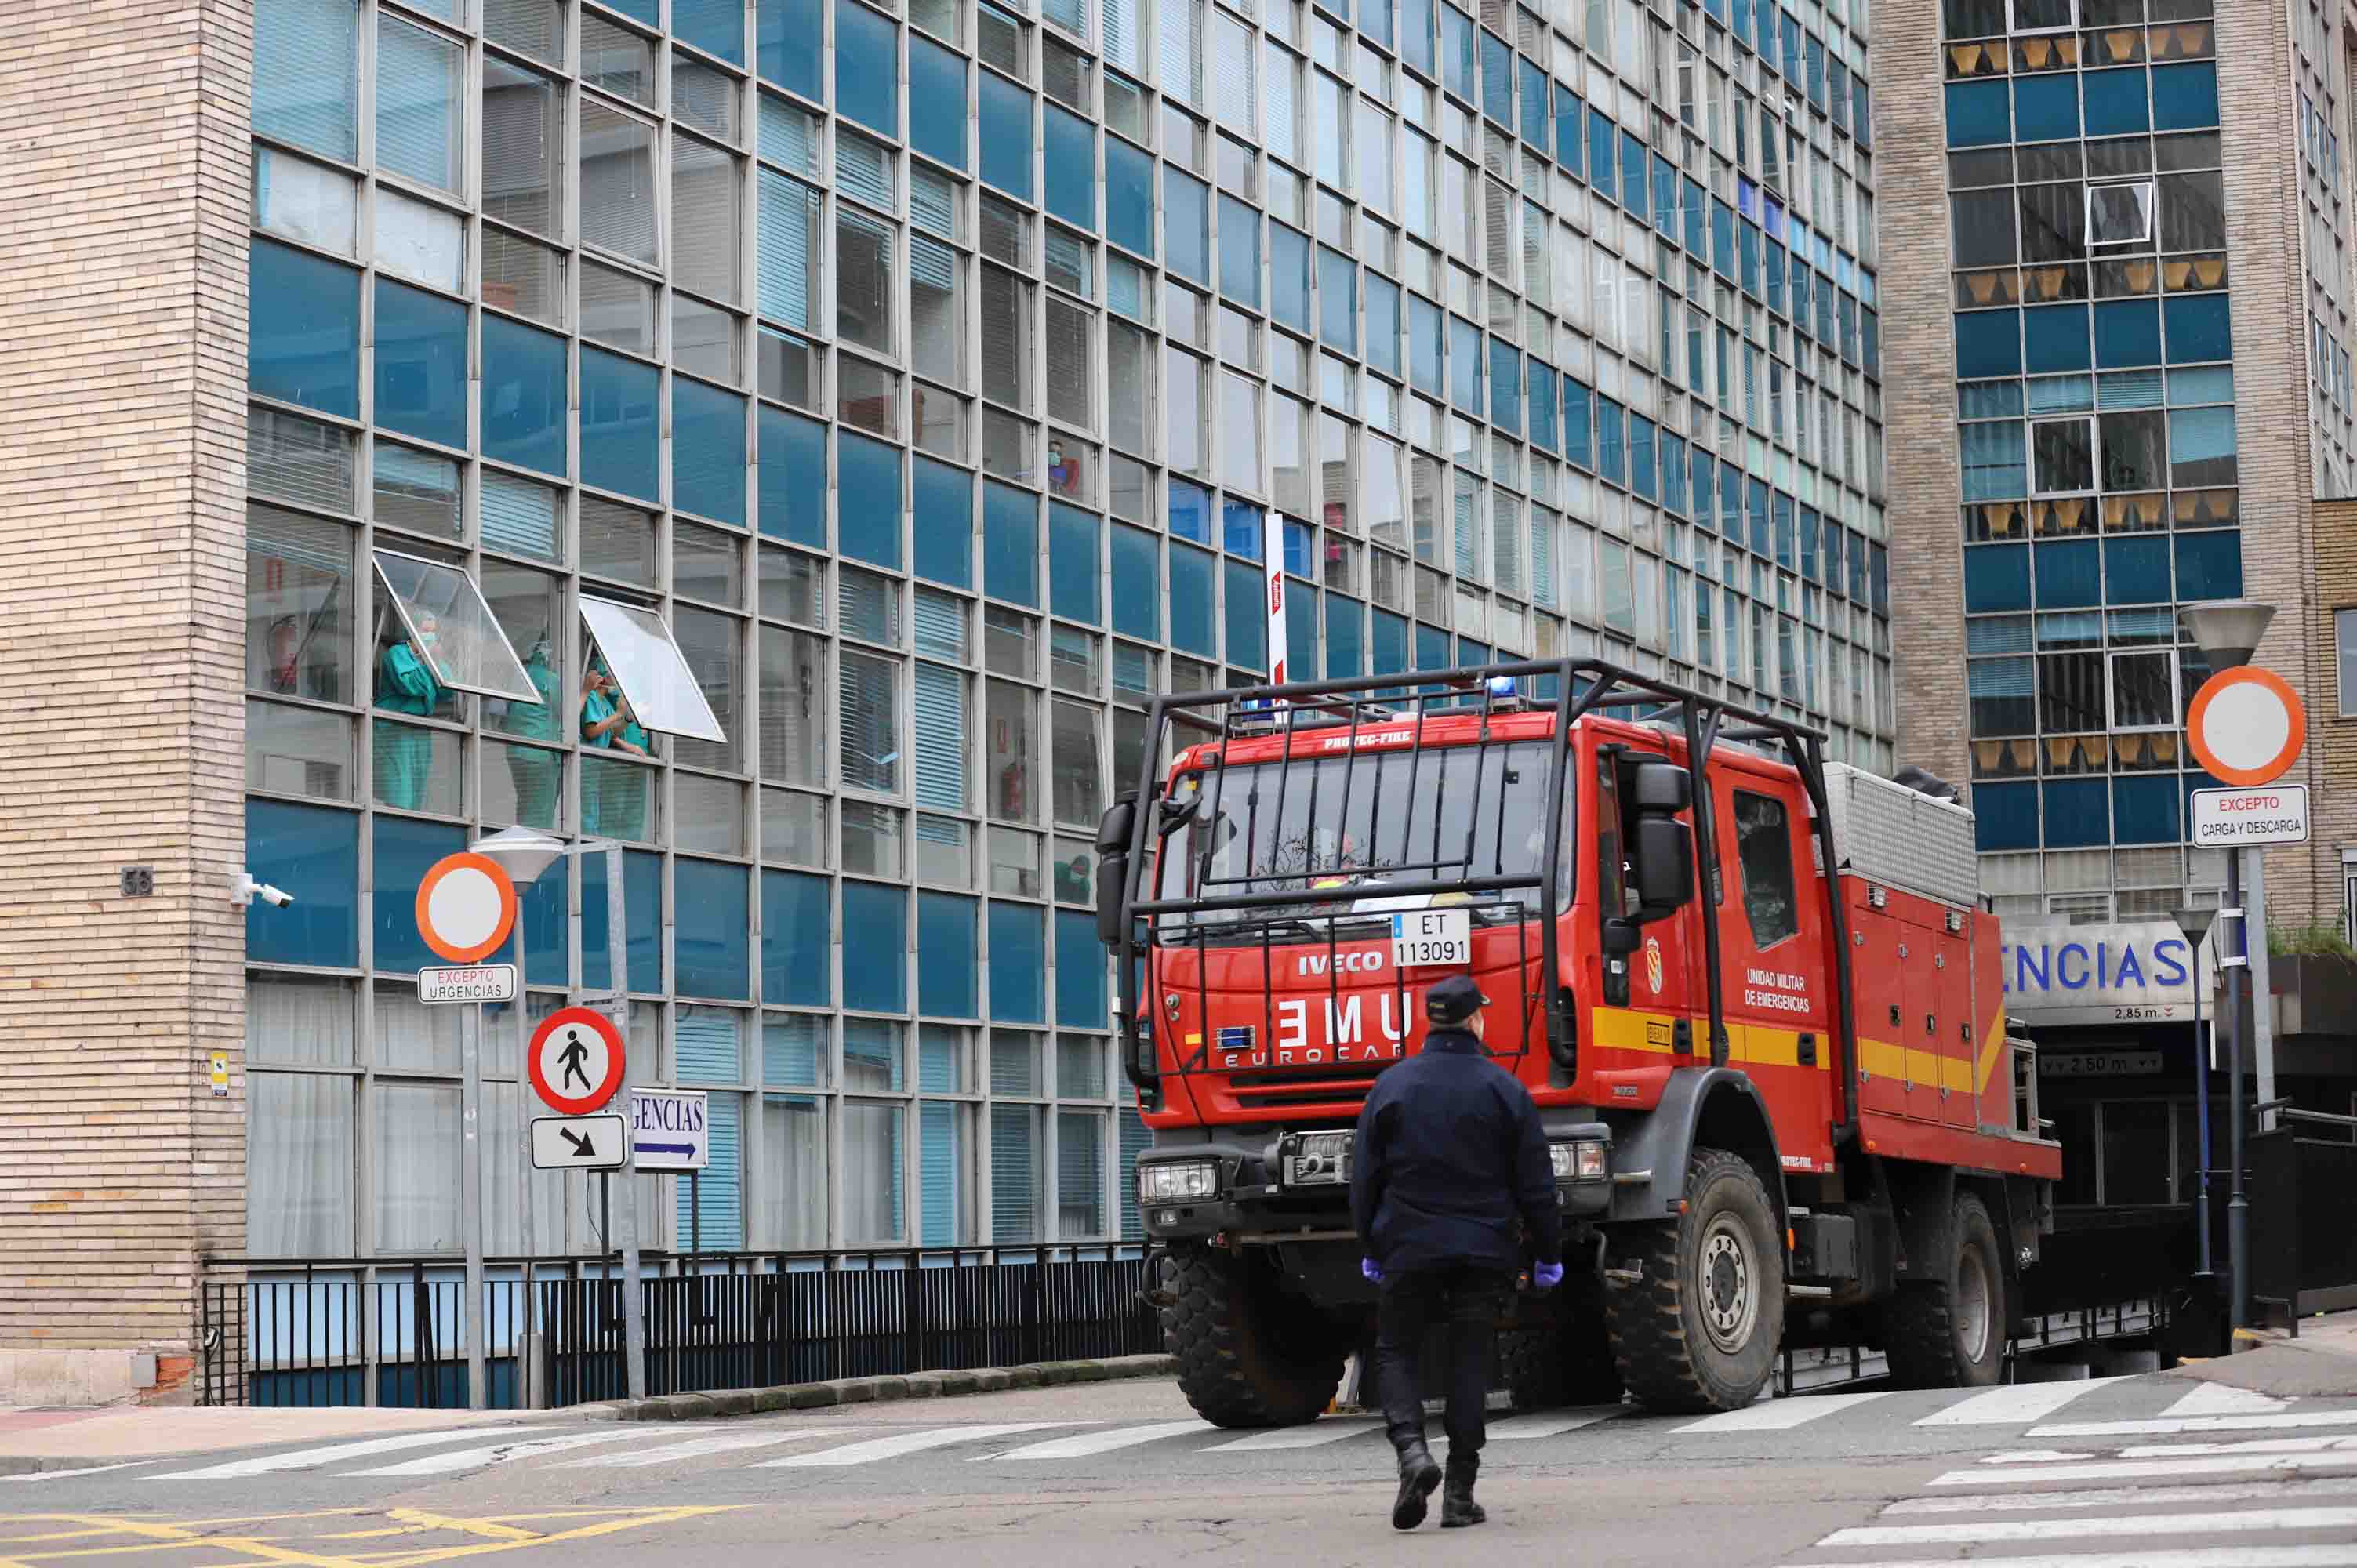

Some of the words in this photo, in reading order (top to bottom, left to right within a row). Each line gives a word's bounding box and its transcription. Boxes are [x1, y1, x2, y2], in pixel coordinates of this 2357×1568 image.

[2220, 797, 2279, 811] EXCEPTO
[2202, 823, 2235, 837] CARGA
[2235, 823, 2244, 835] Y
[2246, 819, 2302, 834] DESCARGA
[1422, 914, 1447, 935] ET
[1398, 940, 1465, 963] 113091
[1298, 951, 1384, 976] IVECO
[438, 971, 495, 984] EXCEPTO
[1746, 967, 1776, 987] UNIDAD
[1776, 972, 1806, 991] MILITAR
[430, 985, 503, 998] URGENCIAS
[1745, 989, 1756, 1005] DE
[1756, 991, 1810, 1013] EMERGENCIAS
